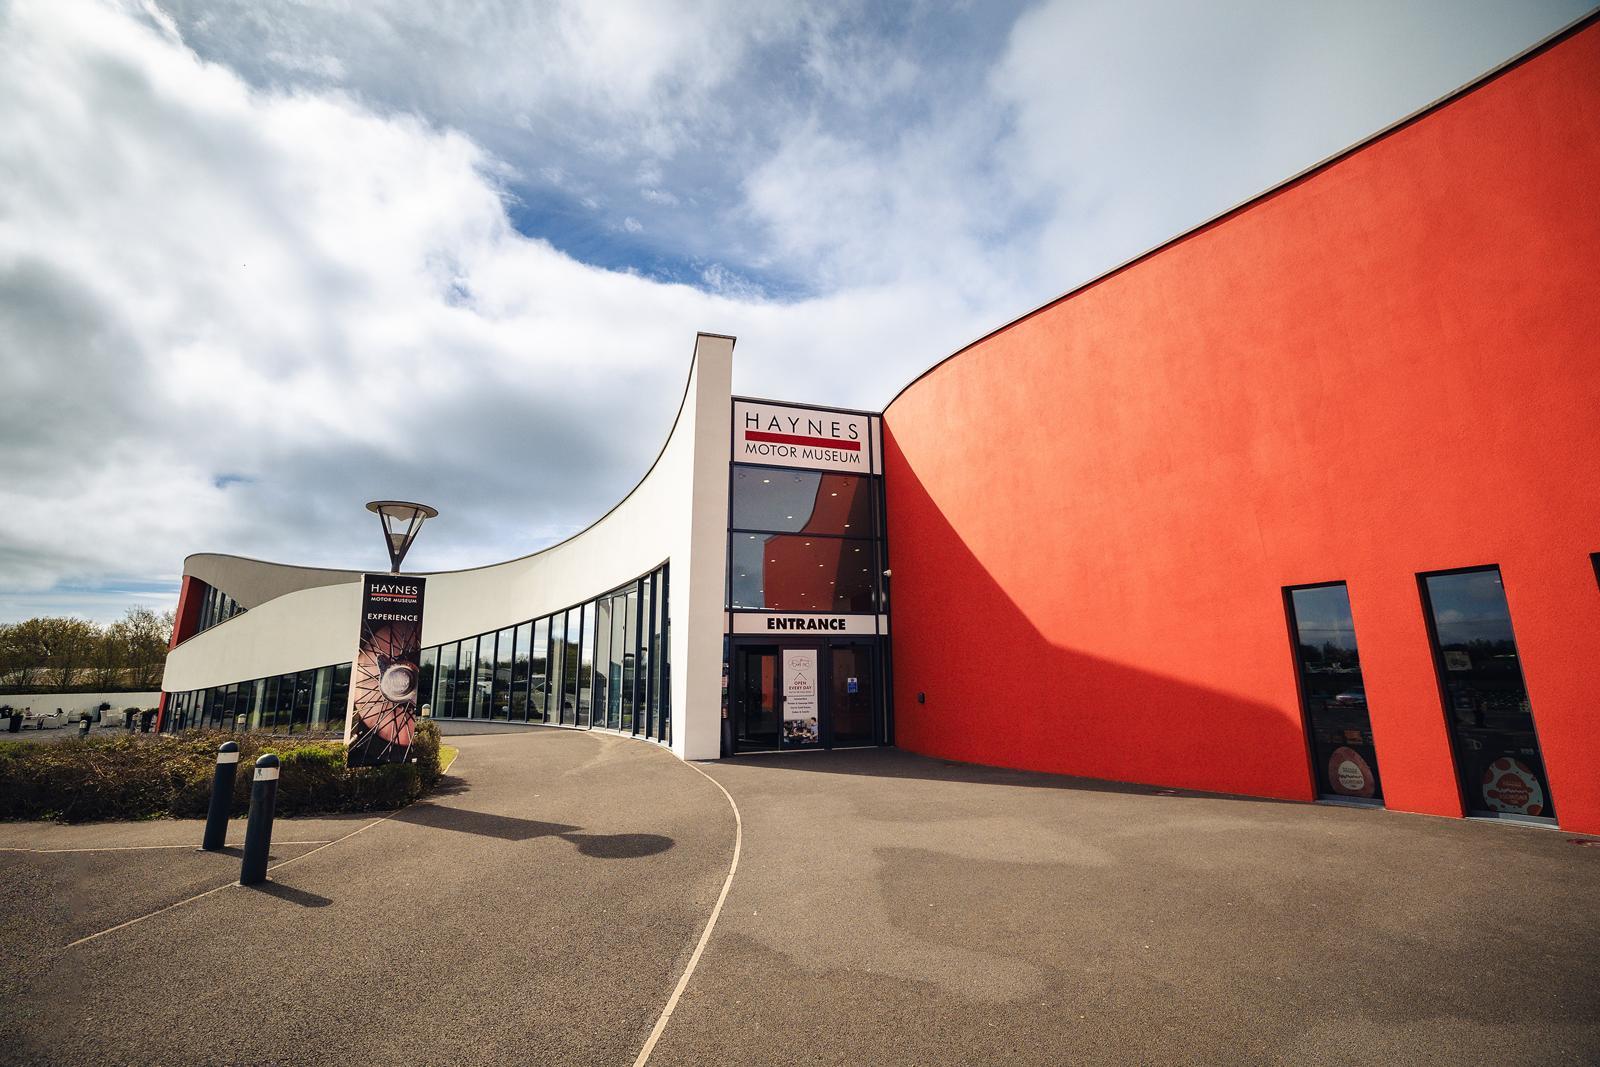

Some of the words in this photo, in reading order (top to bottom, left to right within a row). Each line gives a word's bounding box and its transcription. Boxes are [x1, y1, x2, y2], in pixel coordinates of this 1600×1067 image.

[745, 412, 858, 440] HAYNES
[745, 443, 797, 458] MOTOR
[802, 449, 860, 464] MUSEUM
[371, 584, 418, 595] HAYNES
[367, 613, 418, 622] EXPERIENCE
[767, 618, 846, 630] ENTRANCE
